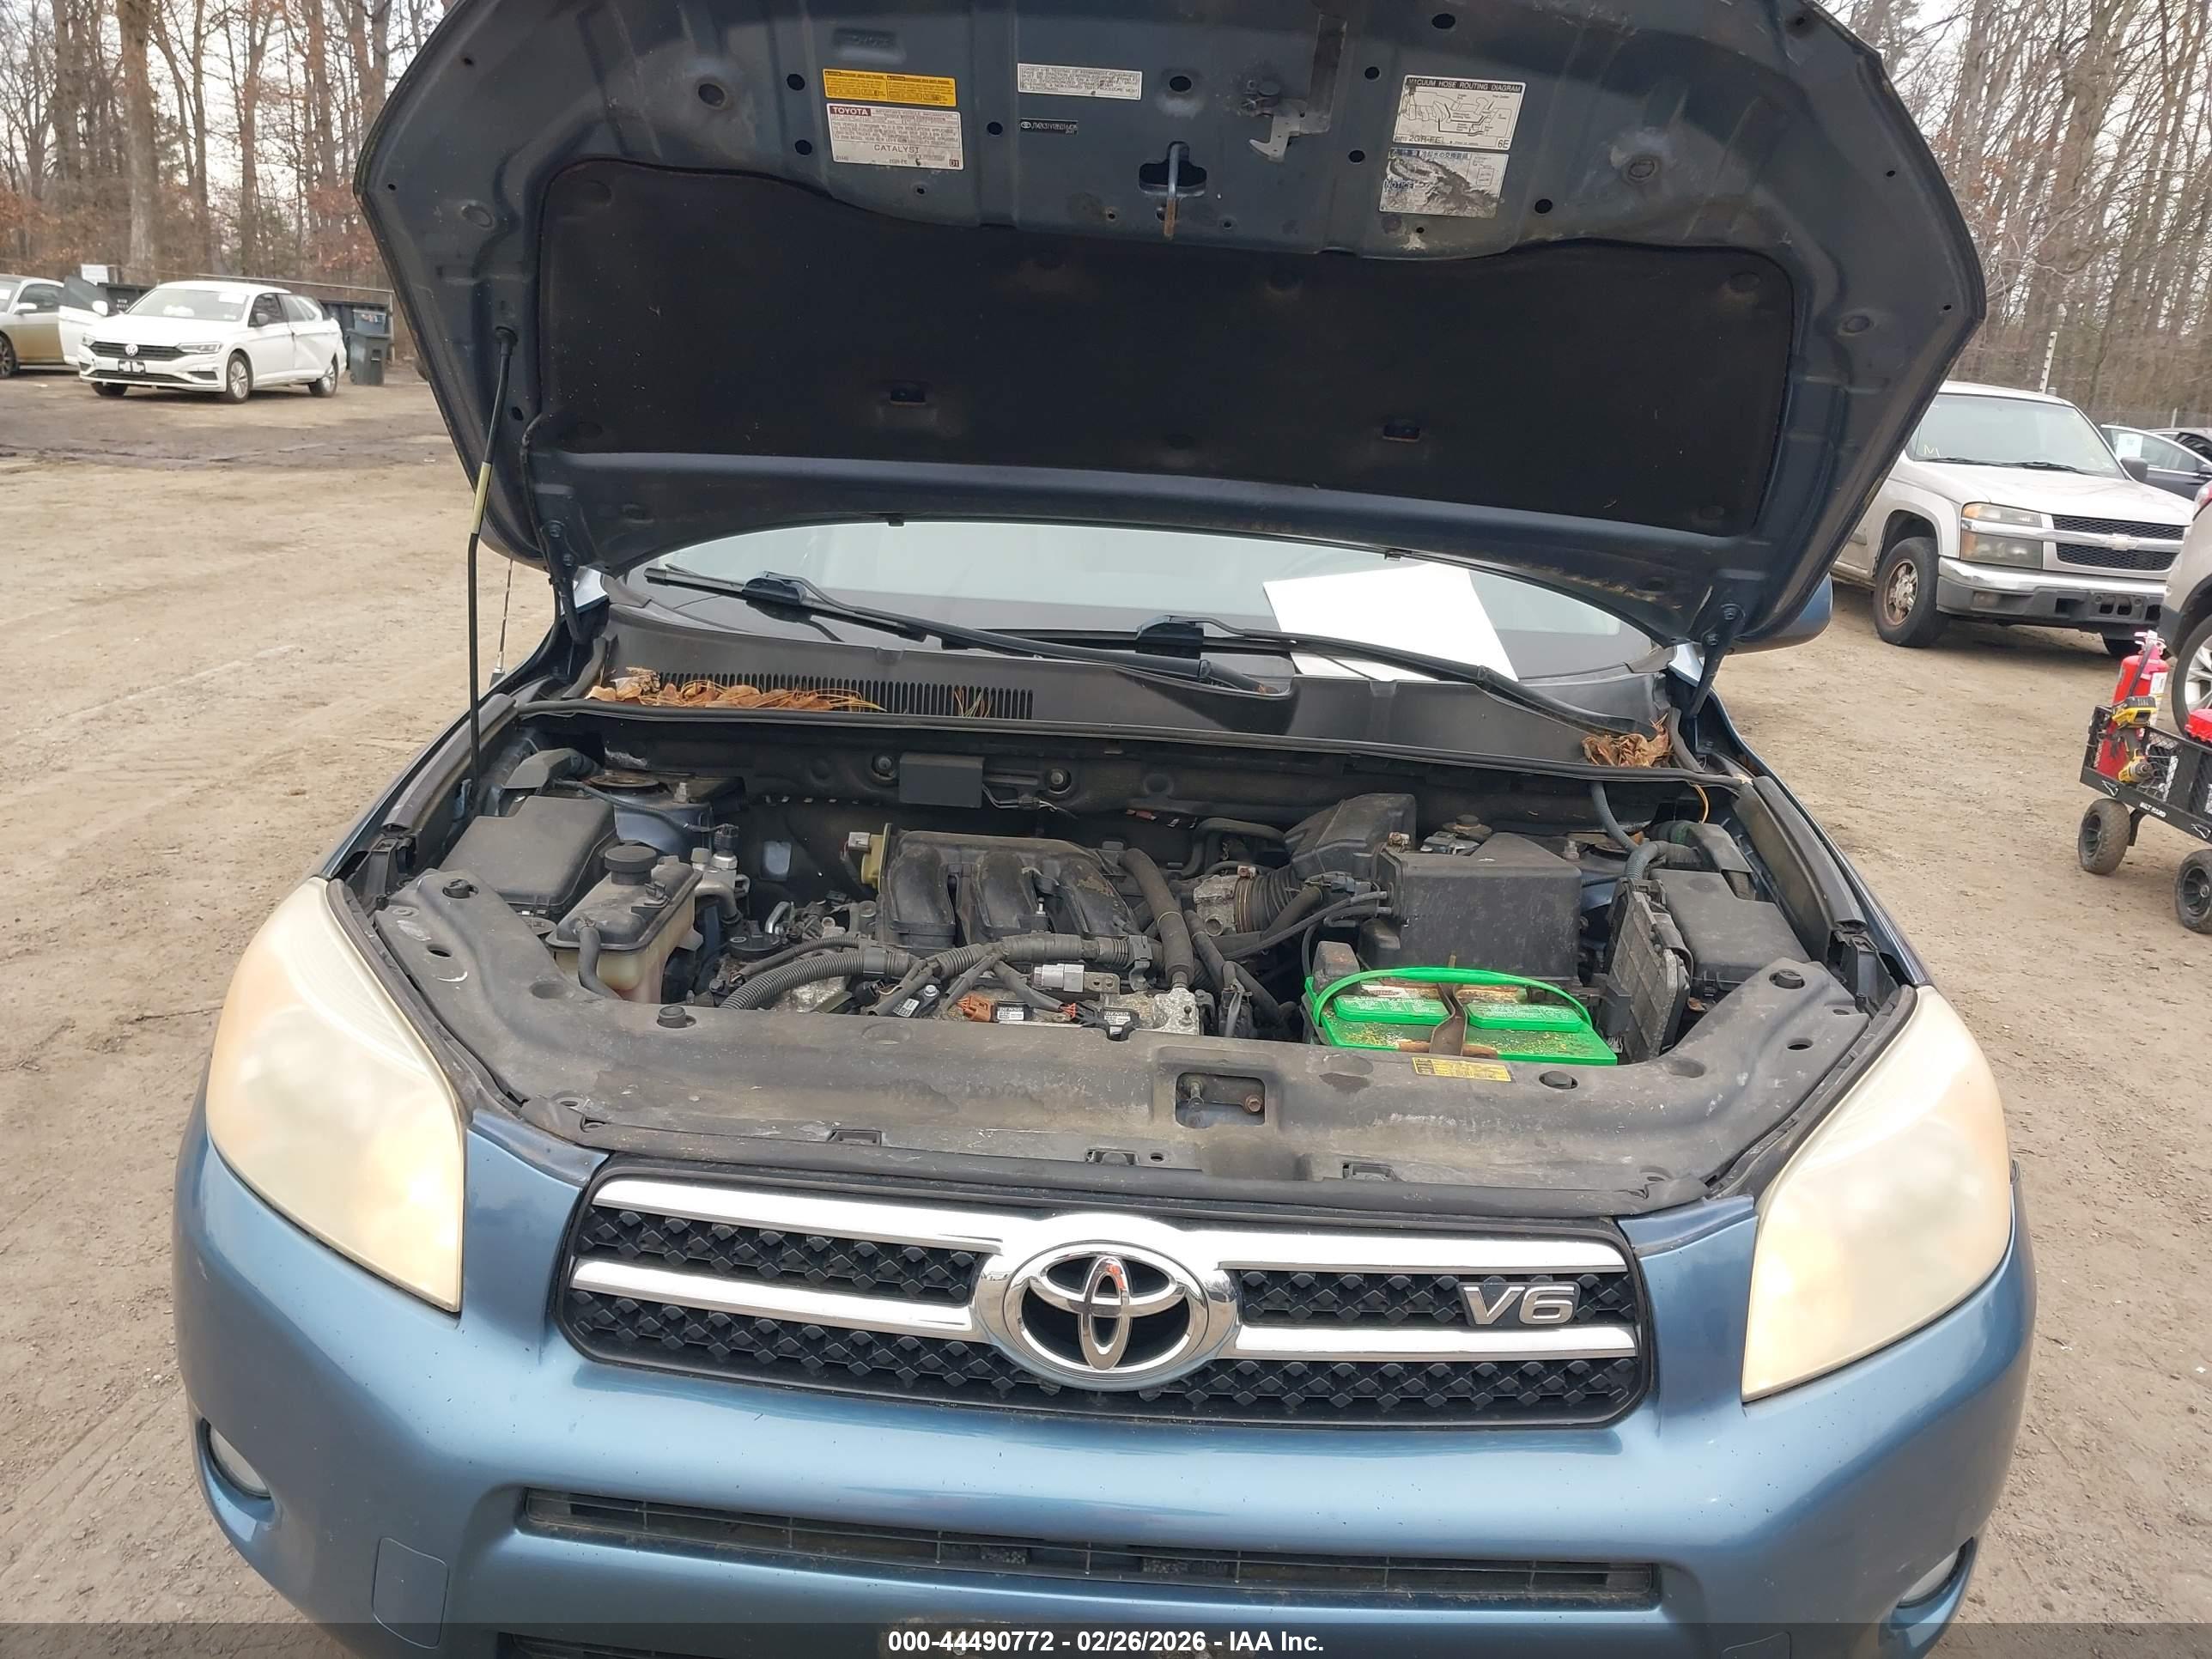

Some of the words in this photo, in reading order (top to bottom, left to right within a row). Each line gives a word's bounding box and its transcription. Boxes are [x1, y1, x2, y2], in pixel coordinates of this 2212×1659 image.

[1459, 82, 1488, 90] ROUTING
[832, 106, 868, 116] TOYOTA
[873, 144, 920, 154] CATALYST
[1498, 139, 1510, 149] 6E
[1463, 1286, 1575, 1325] V6
